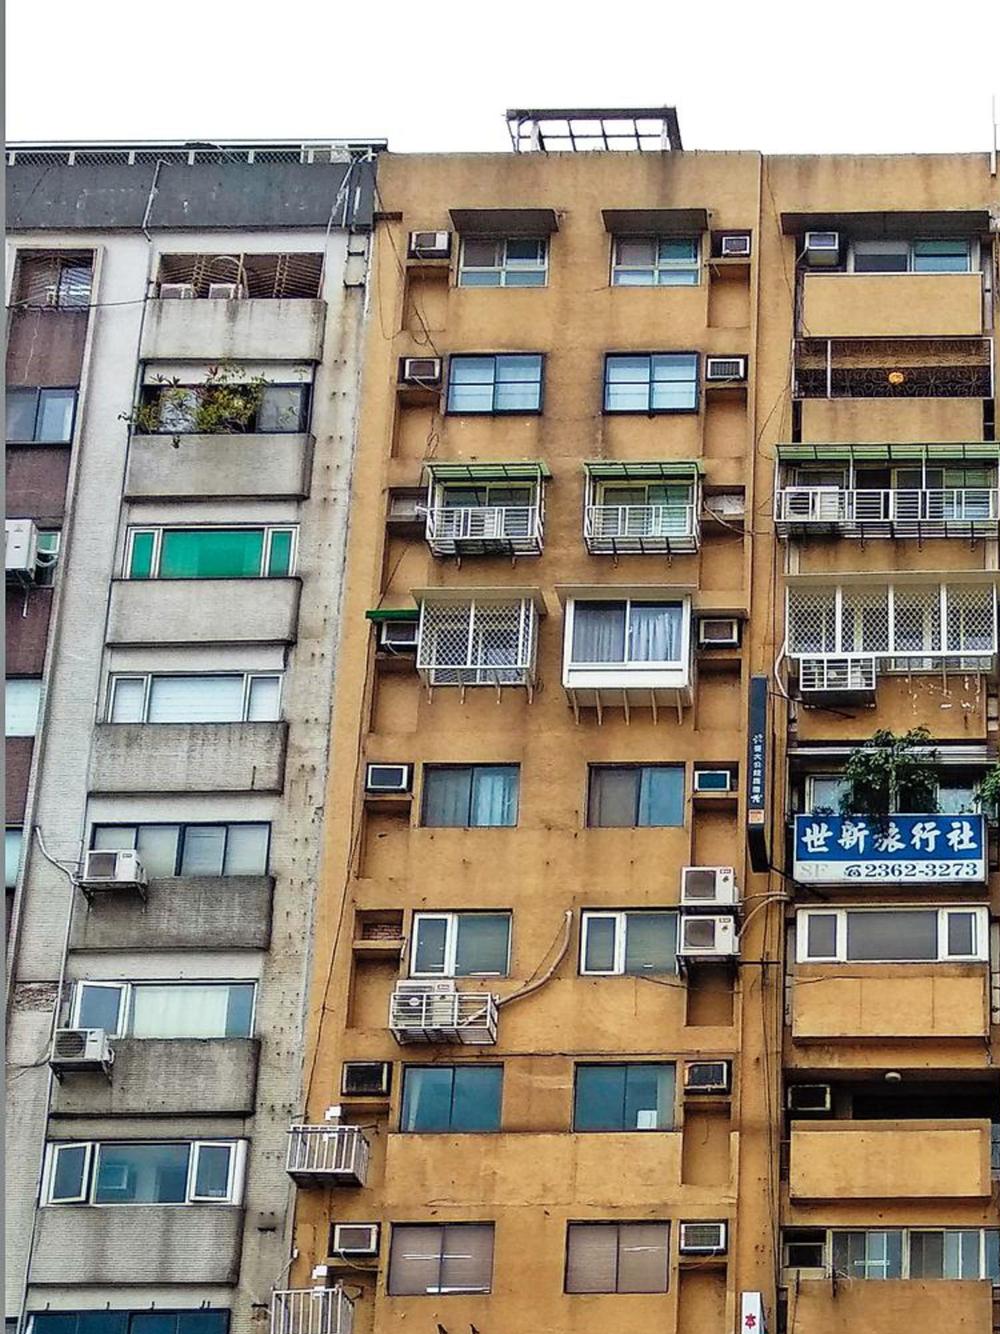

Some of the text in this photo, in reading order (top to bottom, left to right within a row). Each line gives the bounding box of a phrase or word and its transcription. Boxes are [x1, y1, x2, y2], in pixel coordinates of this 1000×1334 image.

[801, 821, 978, 854] 世新旅行社
[865, 863, 978, 877] 2362-3273
